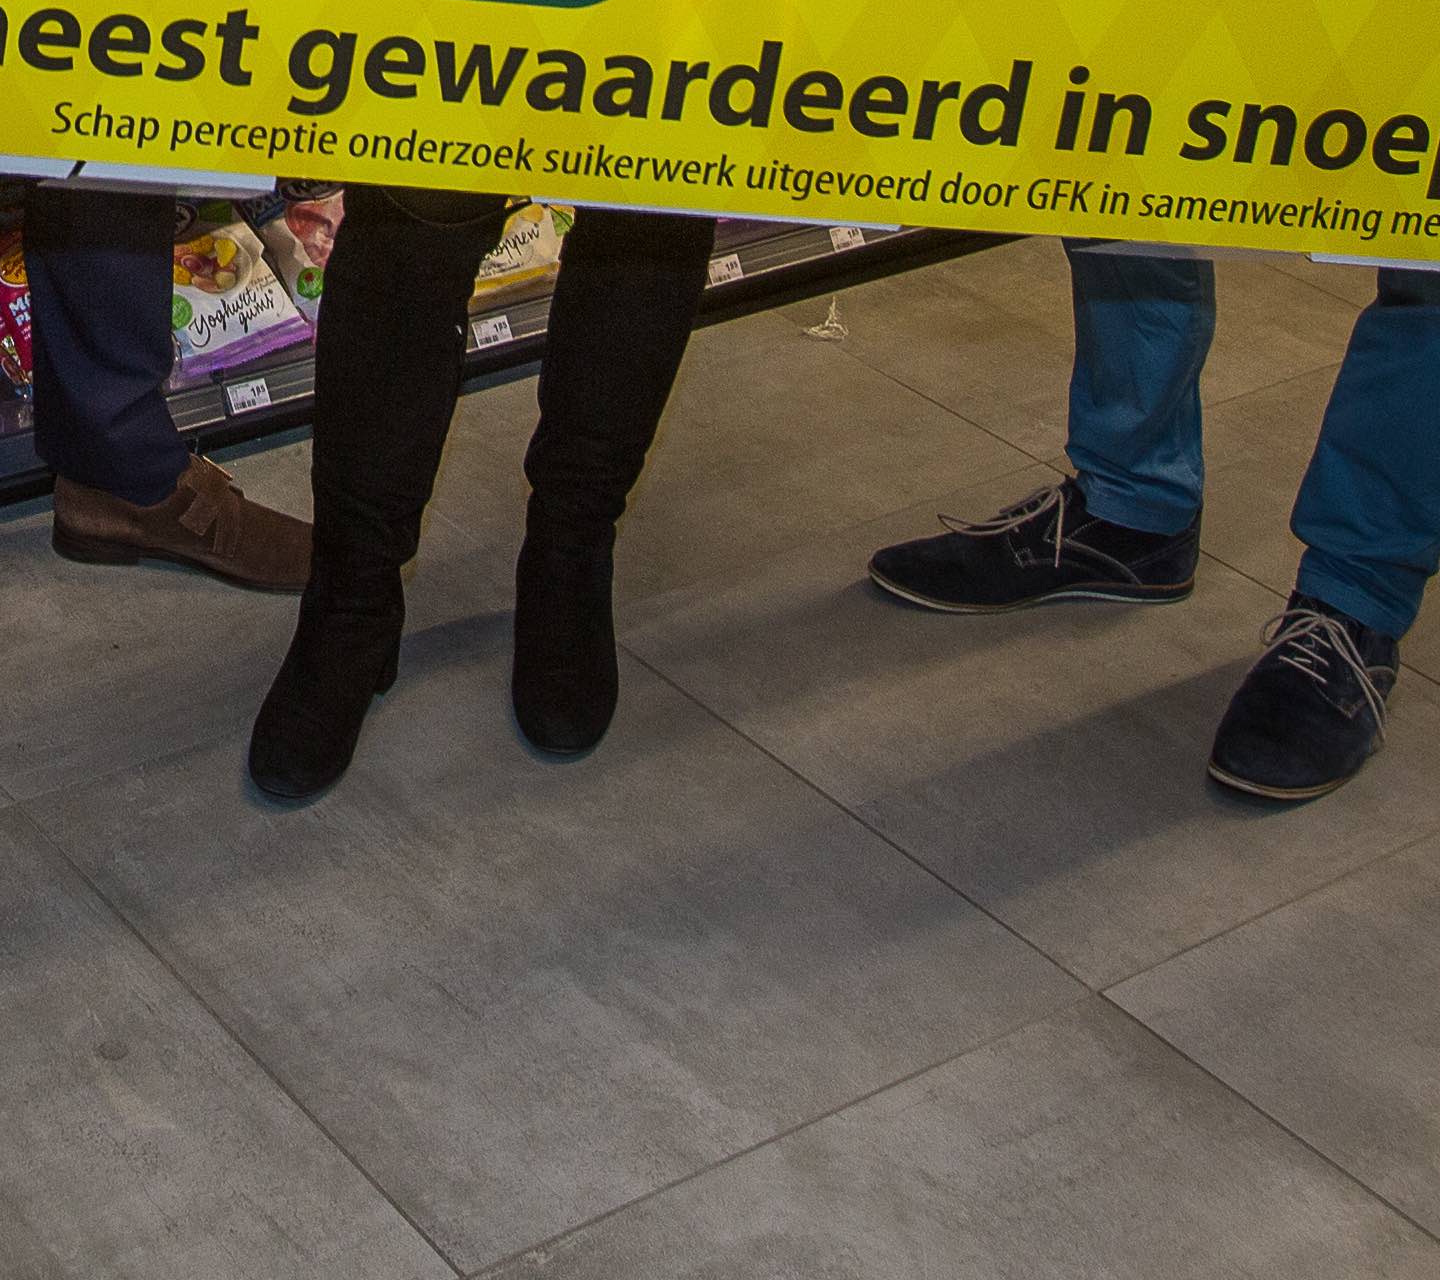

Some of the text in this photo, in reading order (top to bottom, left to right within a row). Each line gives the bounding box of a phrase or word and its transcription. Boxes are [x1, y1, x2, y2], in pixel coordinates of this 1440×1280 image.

[286, 29, 1034, 156] gewaardeerd
[1058, 65, 1152, 156] in
[51, 101, 160, 149] Schap
[169, 110, 338, 160] perceptie
[348, 126, 534, 173] onderzoek
[542, 143, 736, 188] suikerwerk
[746, 160, 932, 205] uitgevoerd
[940, 171, 1020, 209] door
[1026, 178, 1093, 214] GFK
[1099, 184, 1131, 217] in
[1138, 192, 1384, 241] samenwerking
[186, 285, 260, 349] Yoghurt
[236, 291, 276, 335] gums
